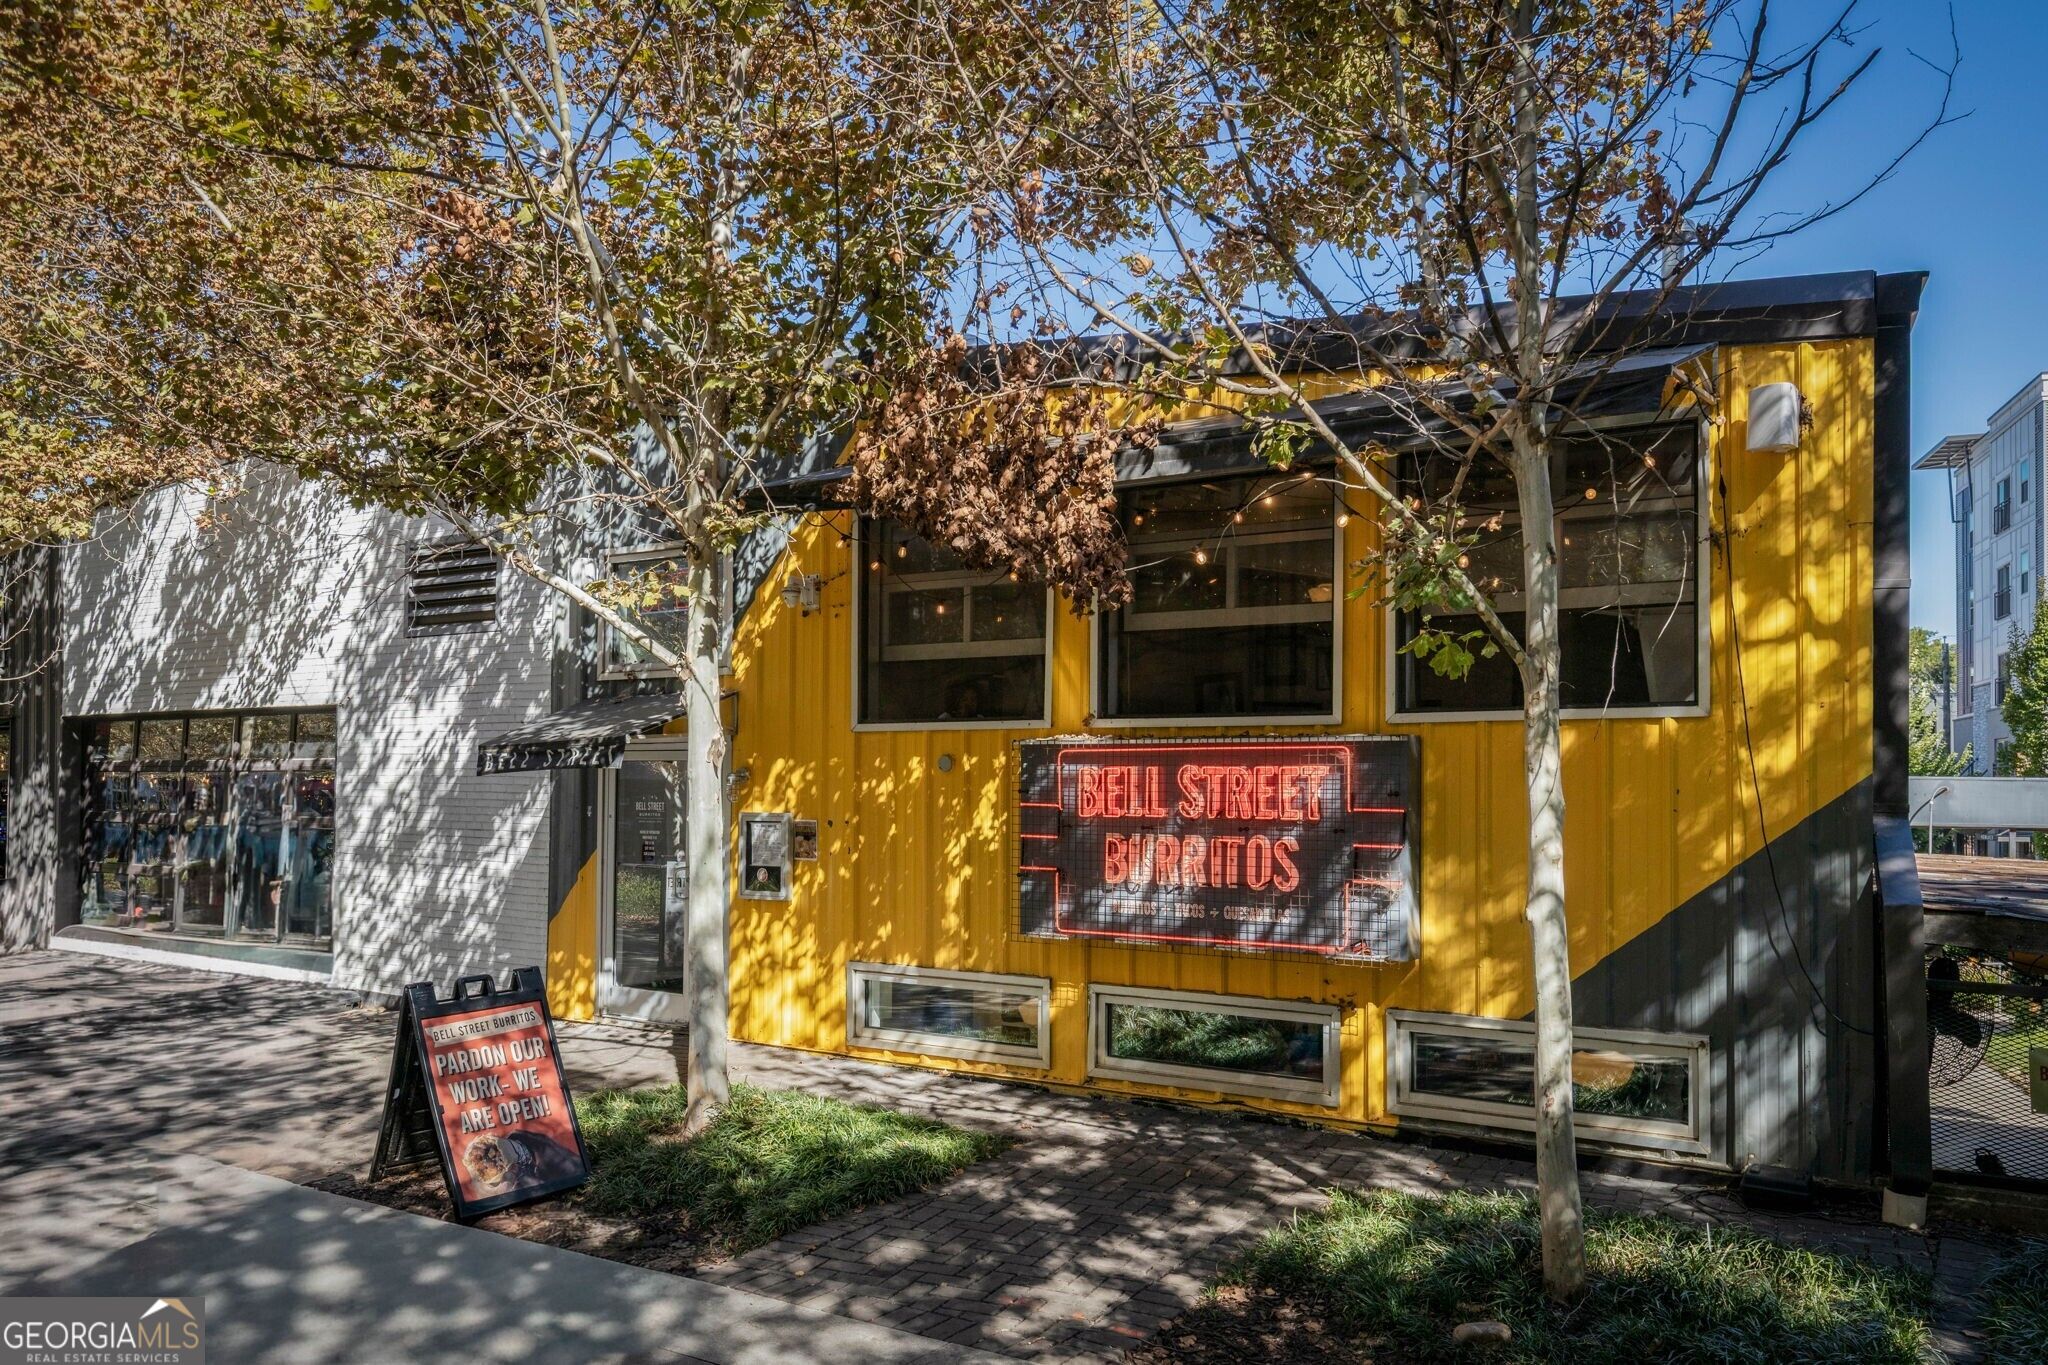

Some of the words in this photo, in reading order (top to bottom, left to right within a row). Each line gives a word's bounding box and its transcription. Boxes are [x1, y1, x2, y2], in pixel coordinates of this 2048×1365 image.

[484, 752, 530, 772] BELL
[635, 801, 646, 811] BELL
[647, 801, 665, 811] STREET
[1078, 765, 1168, 819] BELL
[1178, 764, 1330, 822] STREET
[1104, 832, 1300, 893] BURRITOS
[1174, 902, 1205, 918] TACOS
[433, 1028, 456, 1042] BELL
[459, 1020, 490, 1037] STREET
[493, 1010, 536, 1029] BURRITOS
[434, 1045, 507, 1077] PARDON
[510, 1037, 547, 1063] OUR
[512, 1067, 542, 1092] WE
[461, 1105, 496, 1134] ARE
[499, 1095, 552, 1126] OPEN!
